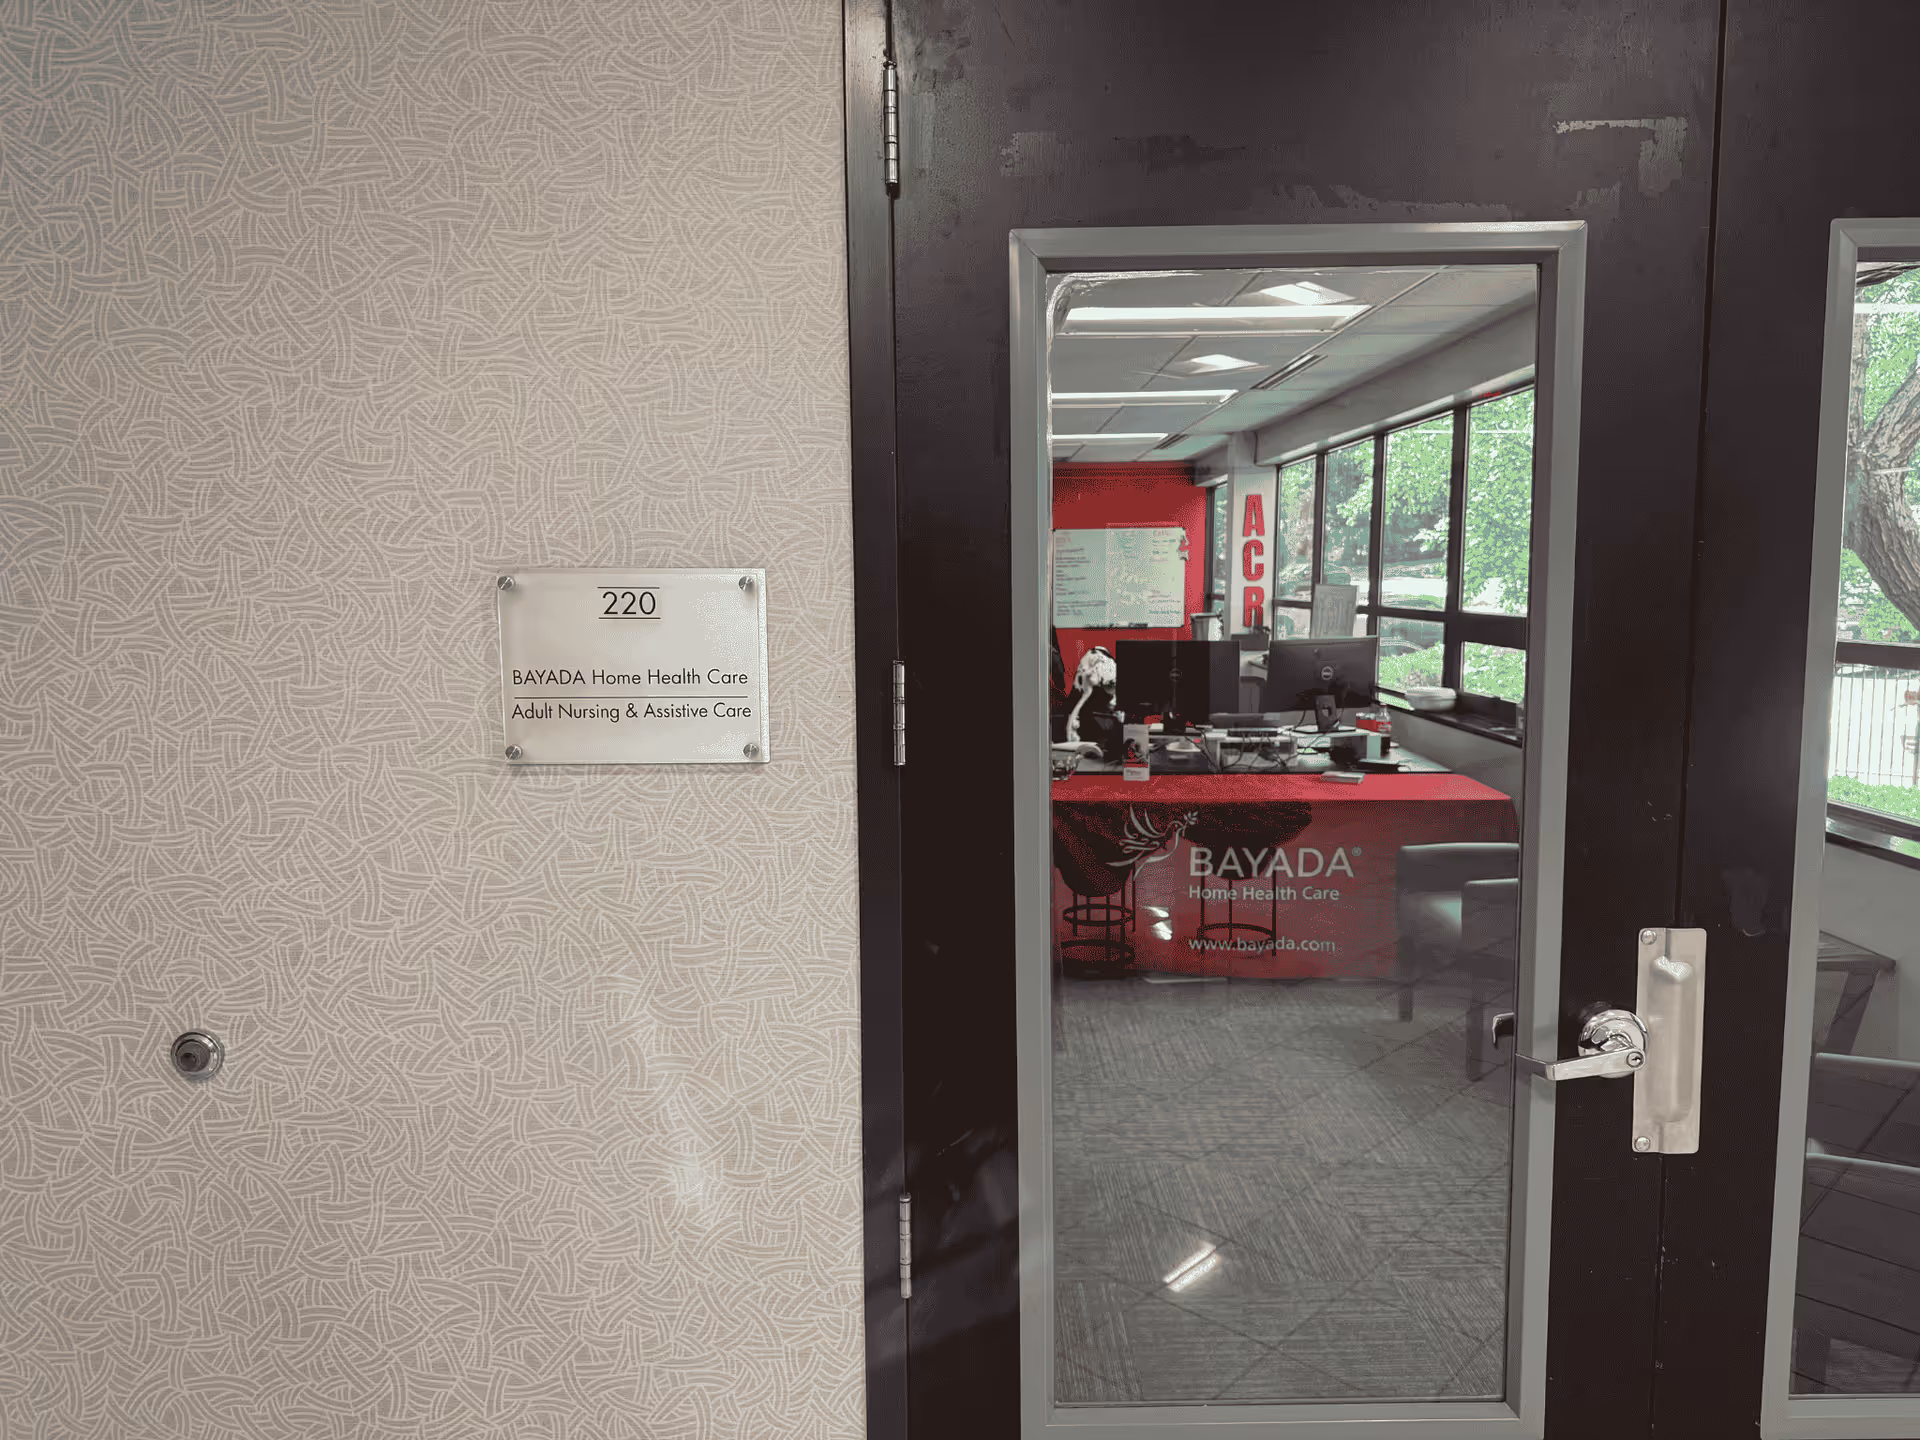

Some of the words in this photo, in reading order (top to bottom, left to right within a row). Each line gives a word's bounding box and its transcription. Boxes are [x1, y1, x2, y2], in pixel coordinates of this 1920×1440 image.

[602, 591, 656, 615] 220
[512, 669, 586, 685] BAYADA
[592, 669, 641, 685] Home
[648, 668, 701, 685] Health
[707, 668, 748, 685] Care
[511, 702, 552, 719] Adult
[558, 703, 620, 723] Nursing
[625, 703, 639, 719] &
[643, 702, 708, 719] Assistive
[713, 702, 752, 718] Care
[1189, 885, 1237, 900] Home
[1243, 885, 1297, 900] Health
[1302, 886, 1340, 900] Care
[1189, 936, 1336, 953] www.bayada.com
